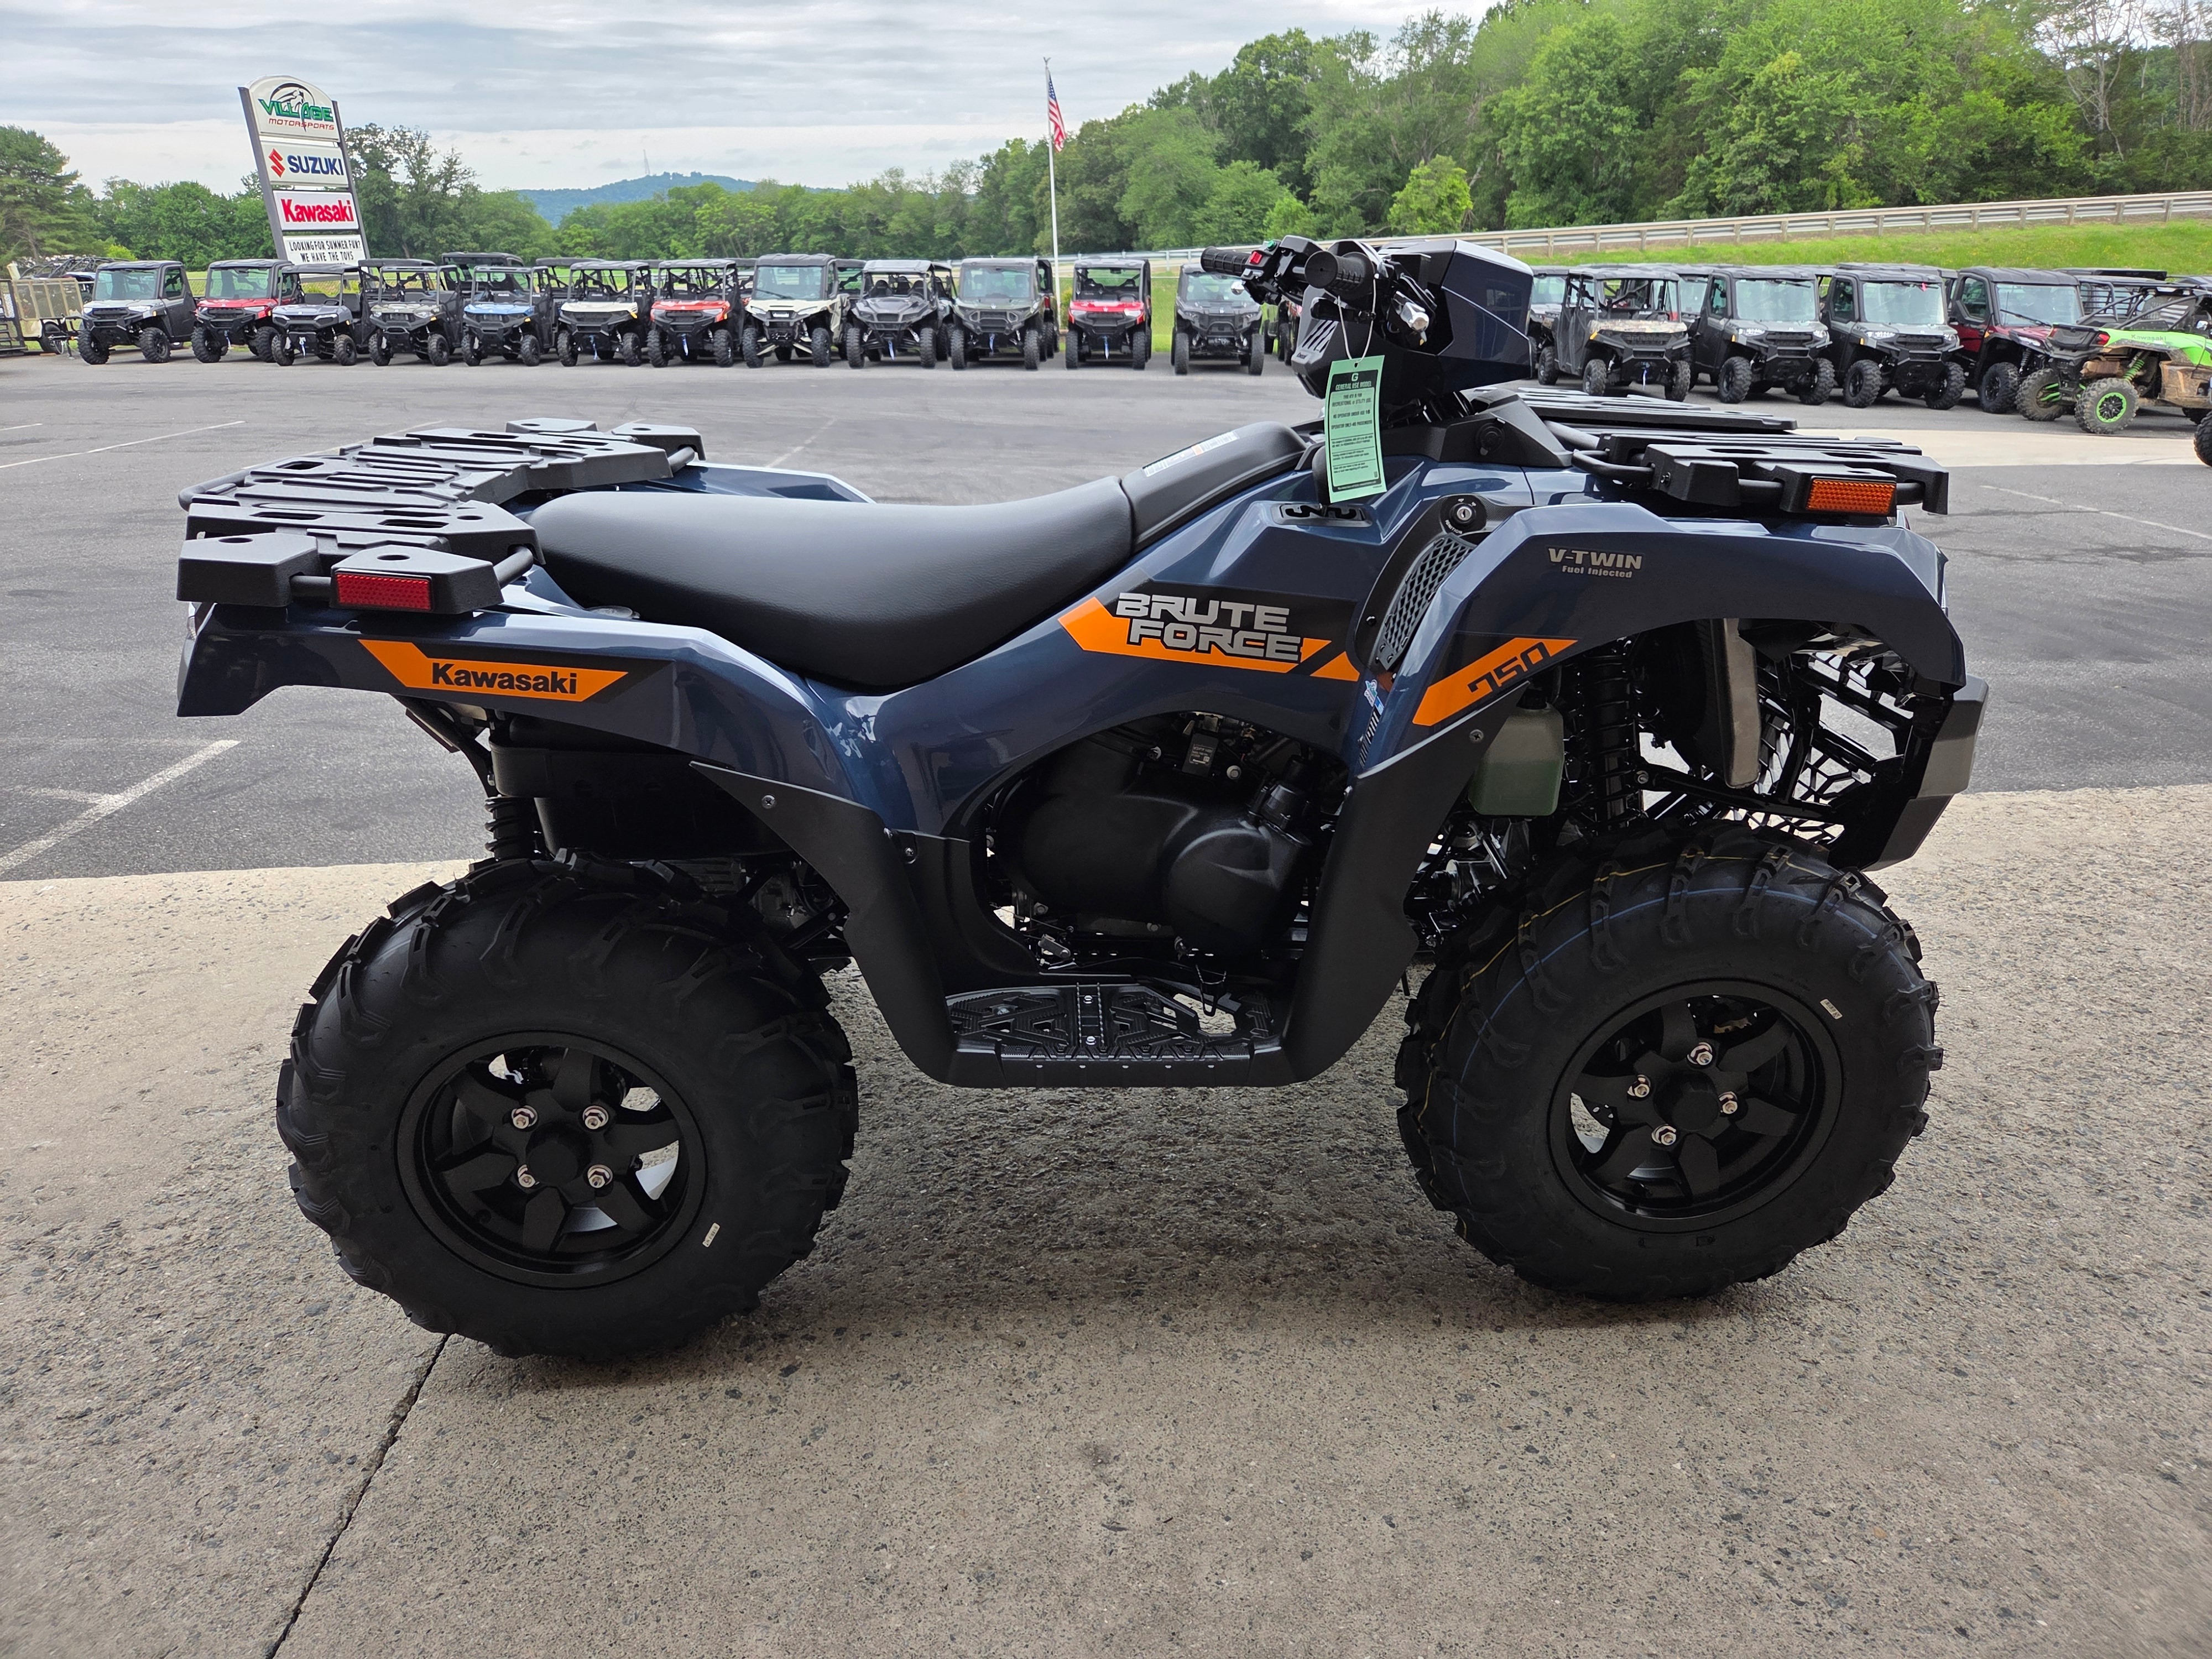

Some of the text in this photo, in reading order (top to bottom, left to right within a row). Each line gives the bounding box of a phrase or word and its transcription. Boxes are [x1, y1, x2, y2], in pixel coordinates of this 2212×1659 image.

[258, 98, 334, 122] VILLAGE
[269, 118, 335, 130] MOTORSPORTS
[288, 155, 344, 175] SUZUKI
[281, 199, 354, 222] Kawasaki
[289, 241, 314, 251] LOOKING
[314, 241, 326, 250] FOR
[326, 241, 348, 249] SUMMER
[300, 251, 354, 262] WE HAVE THE TOYS
[1352, 373, 1359, 382] G
[1548, 548, 1642, 569] V-TWIN
[1562, 565, 1632, 578] Fuel Injected
[1116, 592, 1290, 633] BRUTE
[1129, 618, 1301, 660] FORCE
[1467, 641, 1551, 692] 750
[432, 662, 577, 694] Kawasaki
